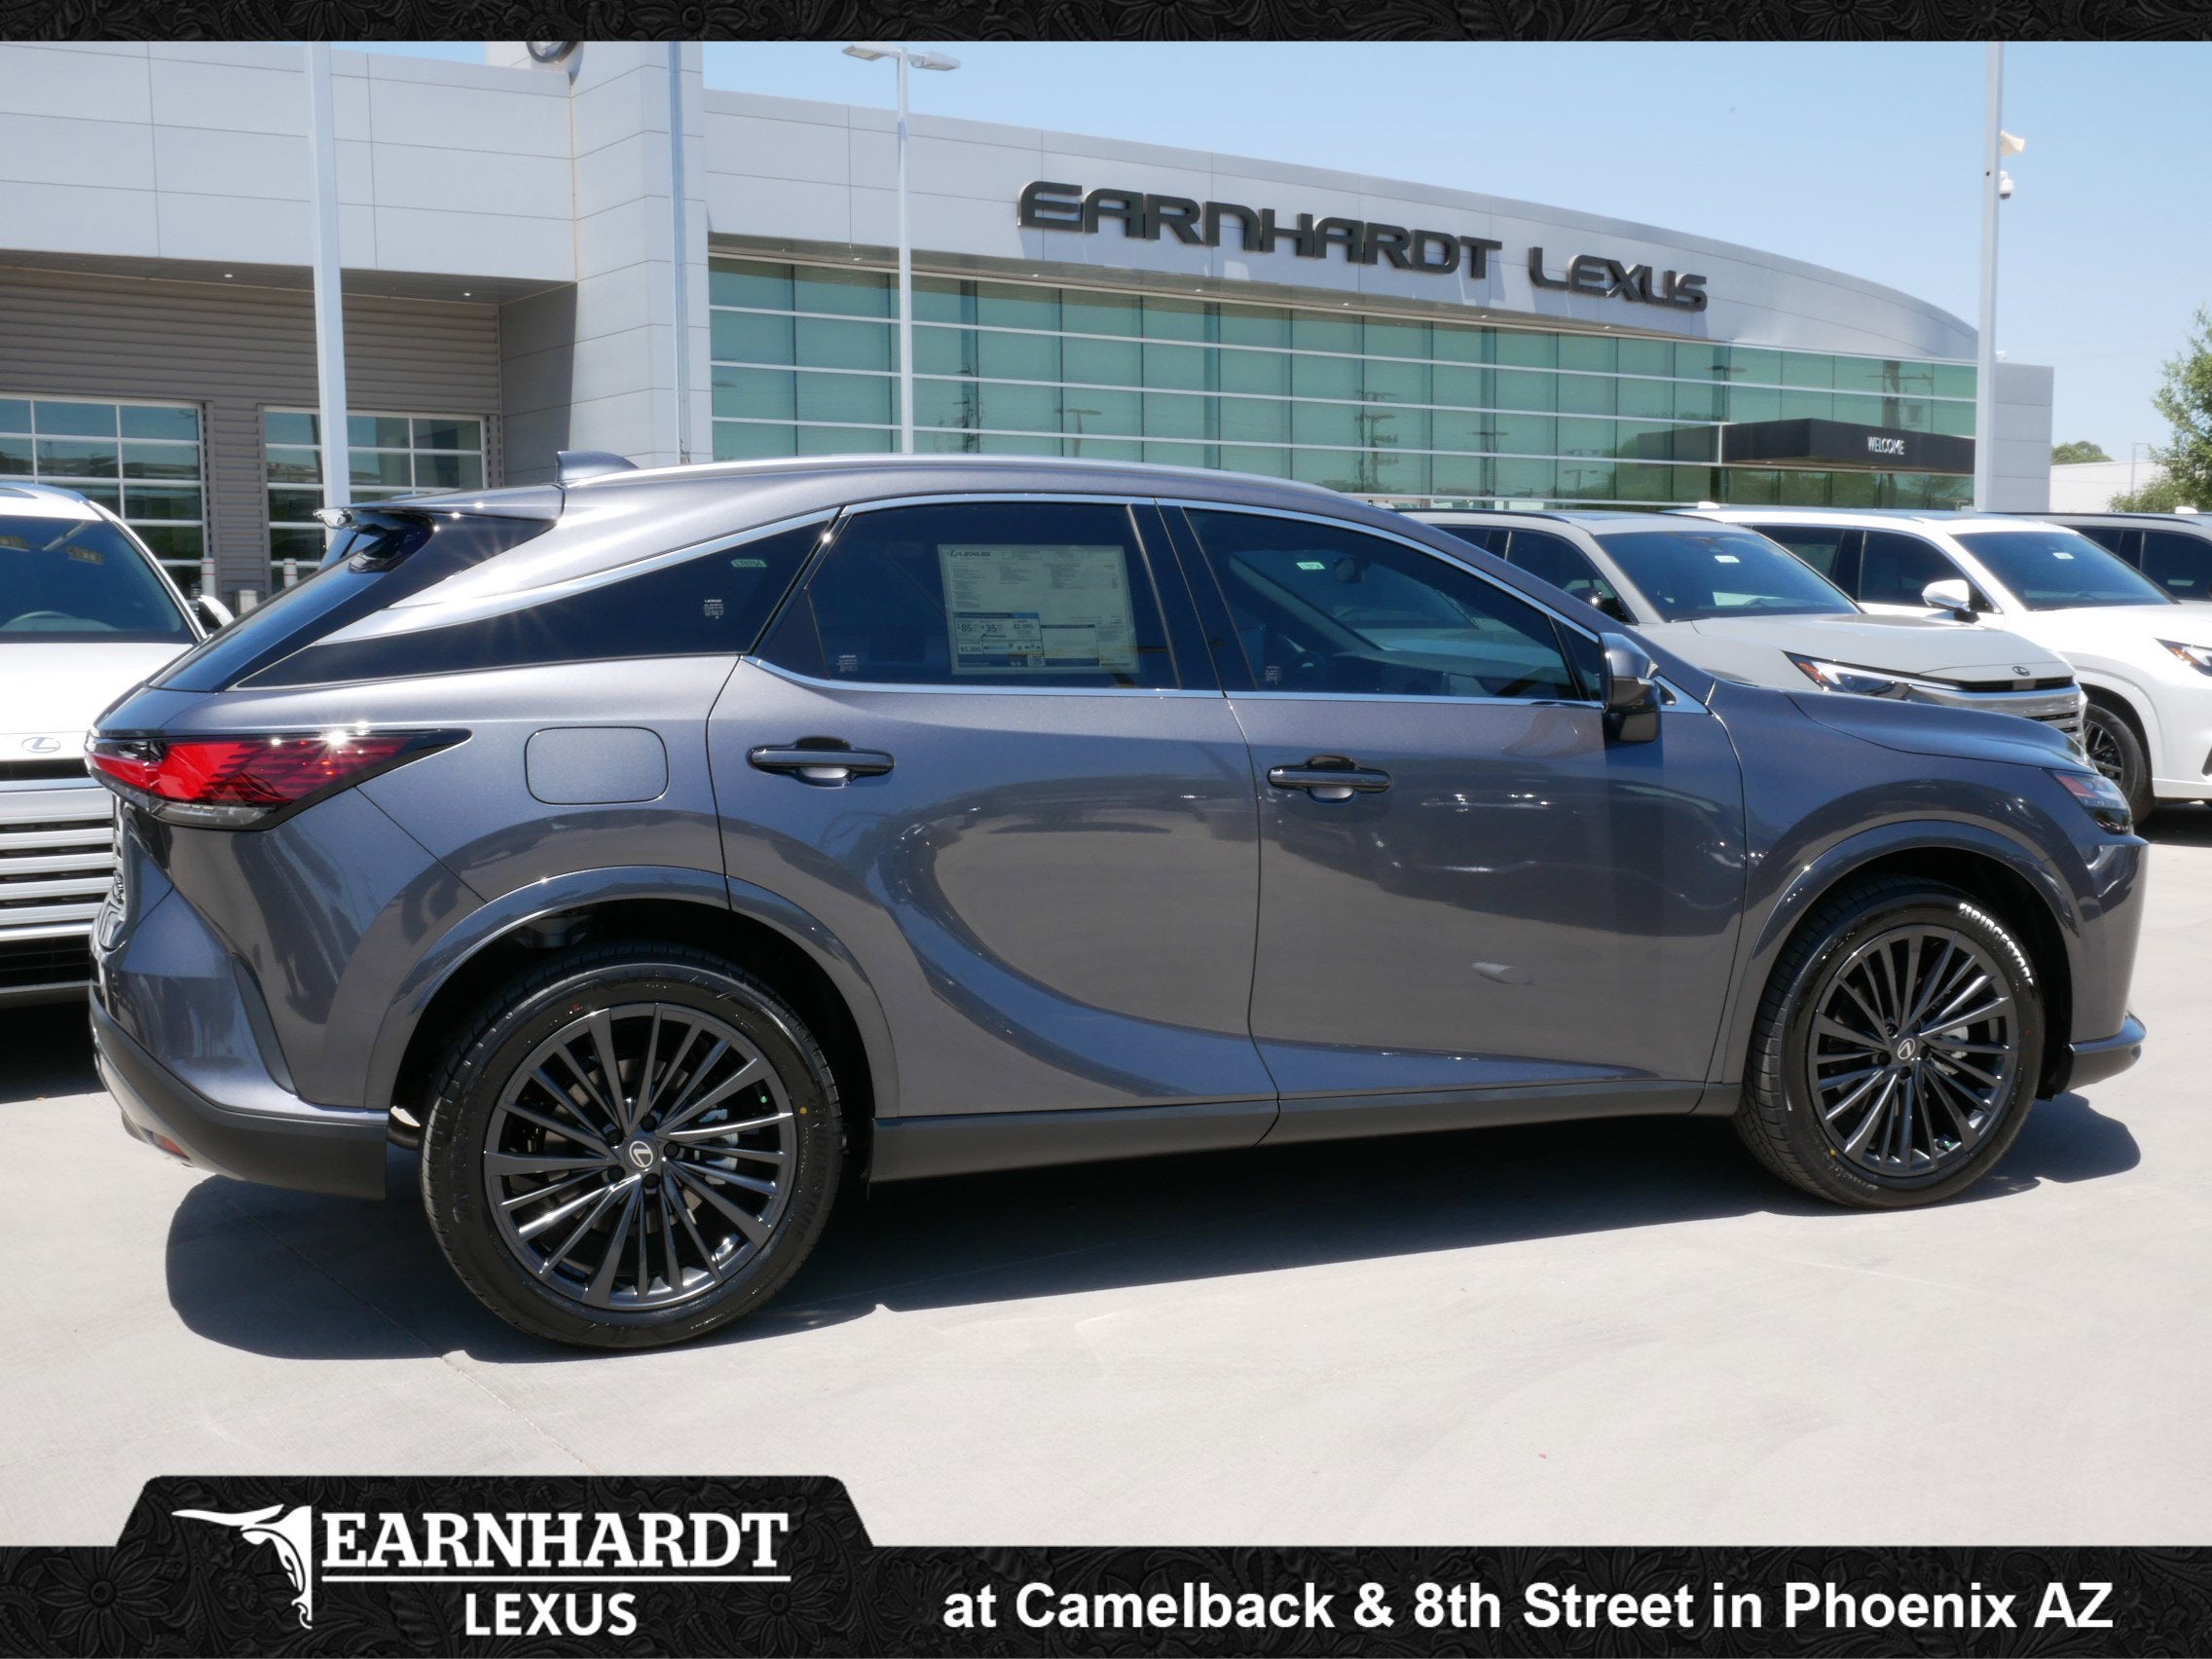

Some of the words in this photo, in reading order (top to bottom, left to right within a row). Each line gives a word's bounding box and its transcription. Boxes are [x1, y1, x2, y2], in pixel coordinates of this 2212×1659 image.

[1017, 181, 1502, 279] EARNHARDT
[1529, 246, 1708, 313] LEXUS
[1867, 436, 1904, 456] WELCOME
